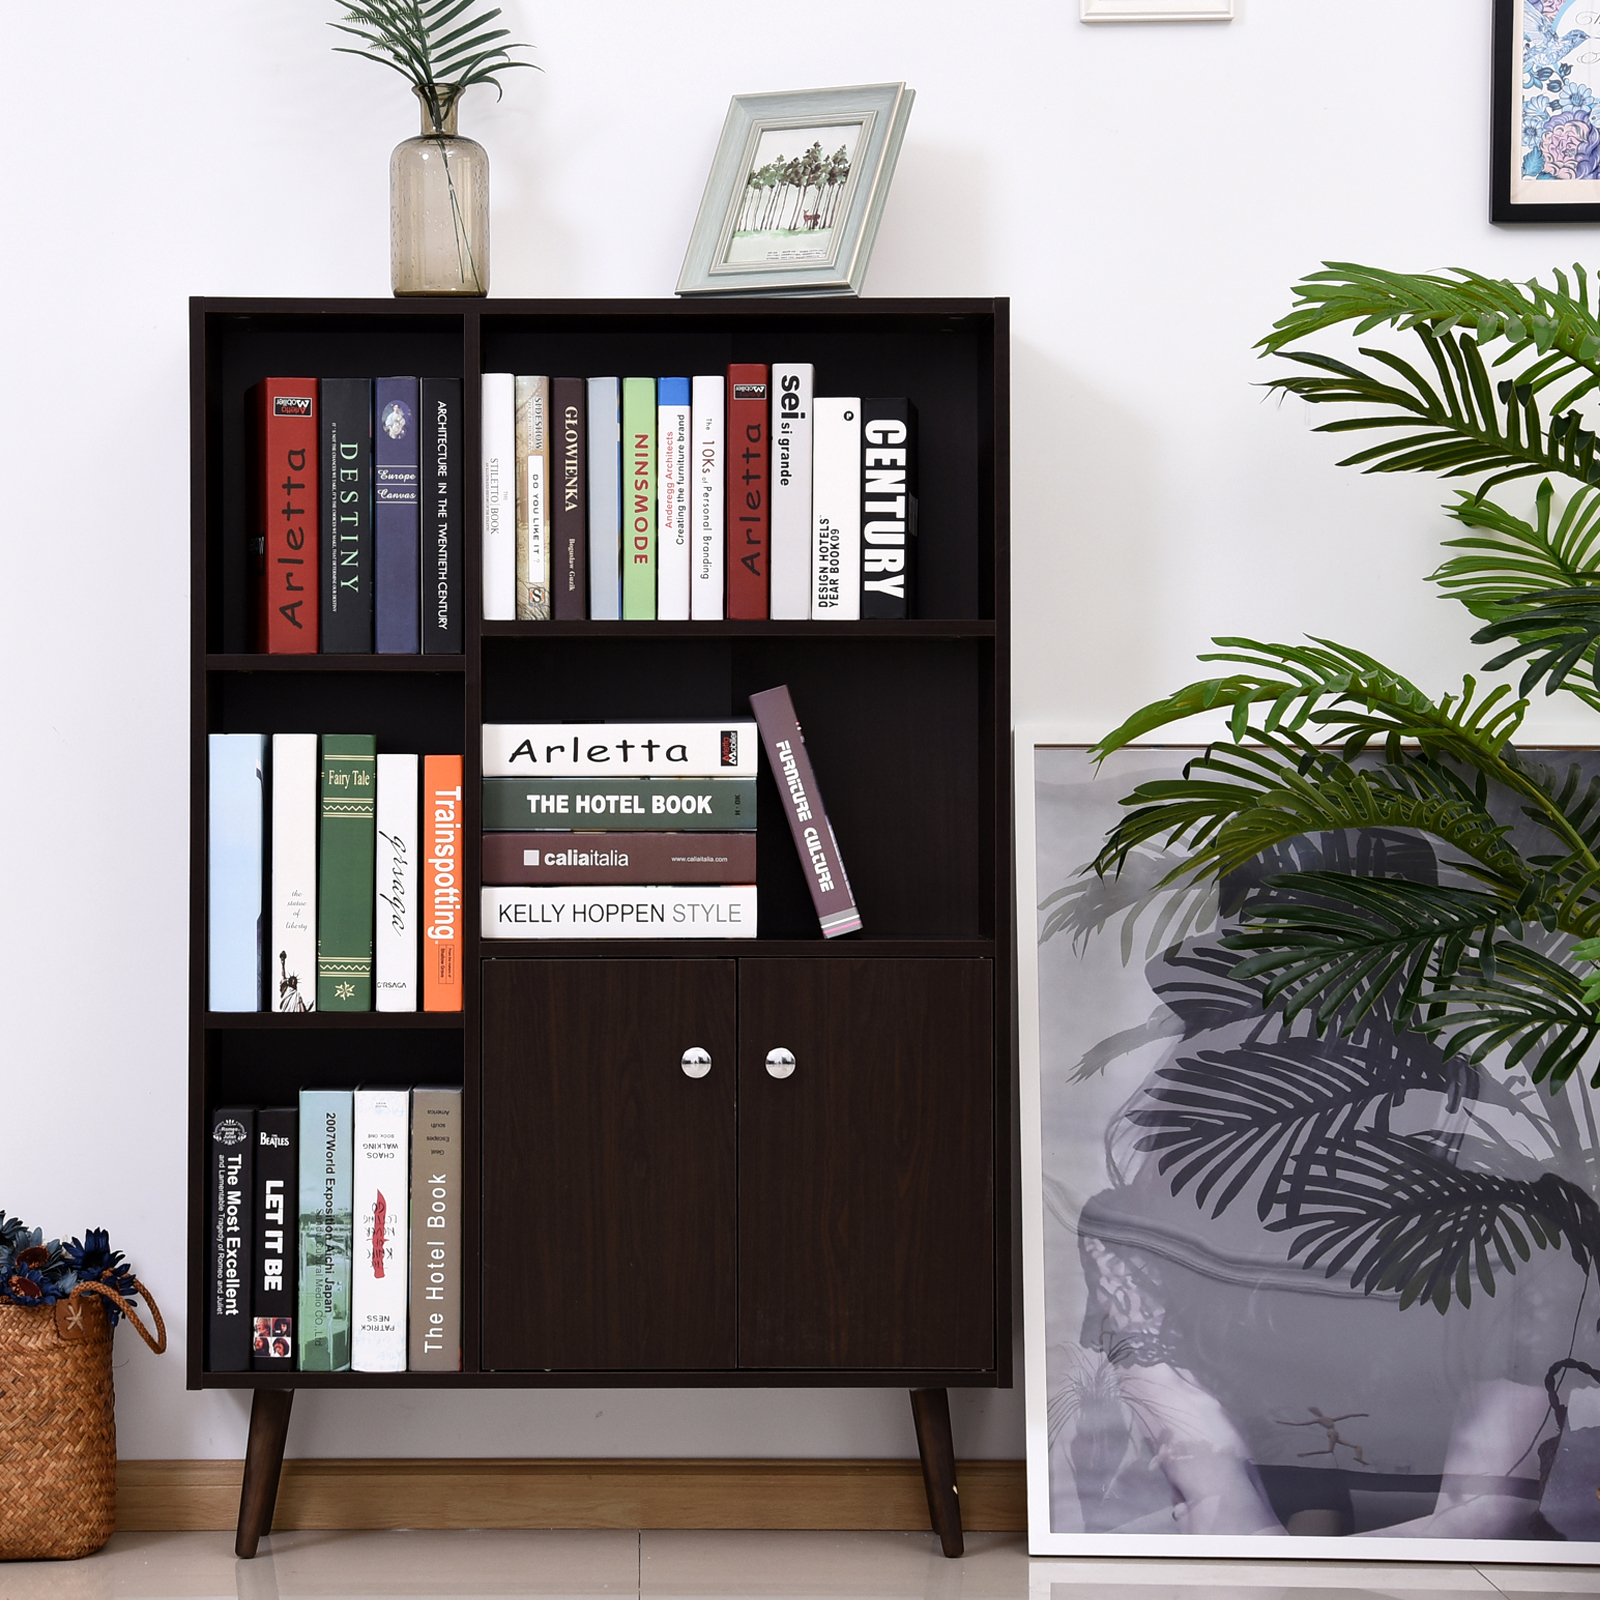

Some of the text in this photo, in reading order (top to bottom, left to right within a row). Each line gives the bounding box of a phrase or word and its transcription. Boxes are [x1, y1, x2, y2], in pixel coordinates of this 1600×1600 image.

[535, 397, 543, 450] SIDESHOW
[778, 374, 806, 486] sei si grande
[702, 440, 715, 474] 10Ks
[377, 469, 416, 482] Europe
[532, 474, 539, 489] DO
[665, 431, 675, 529] Anderegg Architects
[676, 414, 687, 545] Creating the furniture brand
[377, 488, 416, 500] Canvas
[490, 458, 500, 535] STILETTO BOOK
[532, 493, 540, 514] YOU
[634, 434, 649, 564] NINSMODE
[702, 486, 713, 531] Personal
[739, 423, 762, 577] Arletta
[864, 419, 907, 599] CENTURY
[340, 442, 359, 594] DESTINY
[437, 401, 448, 630] ARCHITECTURE IN THE TWENTIETH CENTURY
[277, 448, 306, 629] Arletta
[533, 544, 540, 555] IT
[700, 536, 712, 580] Branding
[818, 566, 829, 608] DESIGN
[829, 577, 839, 608] YEAR
[508, 737, 688, 764] Arletta
[729, 732, 737, 765] Mobilier
[328, 770, 370, 789] Fairy Tale
[527, 794, 713, 814] THE HOTEL BOOK
[775, 740, 835, 893] FURNITURE CULTURE
[427, 786, 461, 941] Trainspotting
[544, 849, 629, 867] caliaitalia
[291, 889, 302, 898] the
[293, 908, 300, 918] of
[499, 904, 742, 923] KELLY HOPPEN STYLE
[260, 1132, 290, 1148] BEATLES
[362, 1142, 399, 1150] WALKING
[217, 1170, 225, 1211] Lamentable
[322, 1178, 336, 1240] Exposition
[216, 1213, 225, 1242] Tragedy
[225, 1153, 242, 1316] The Most Excellent
[264, 1180, 284, 1291] LET IT BE
[217, 1252, 225, 1278] Romeo
[324, 1243, 335, 1274] Aichi
[424, 1173, 447, 1354] The Hotel Book
[216, 1295, 224, 1315] Juliet
[322, 1277, 334, 1313] Japan
